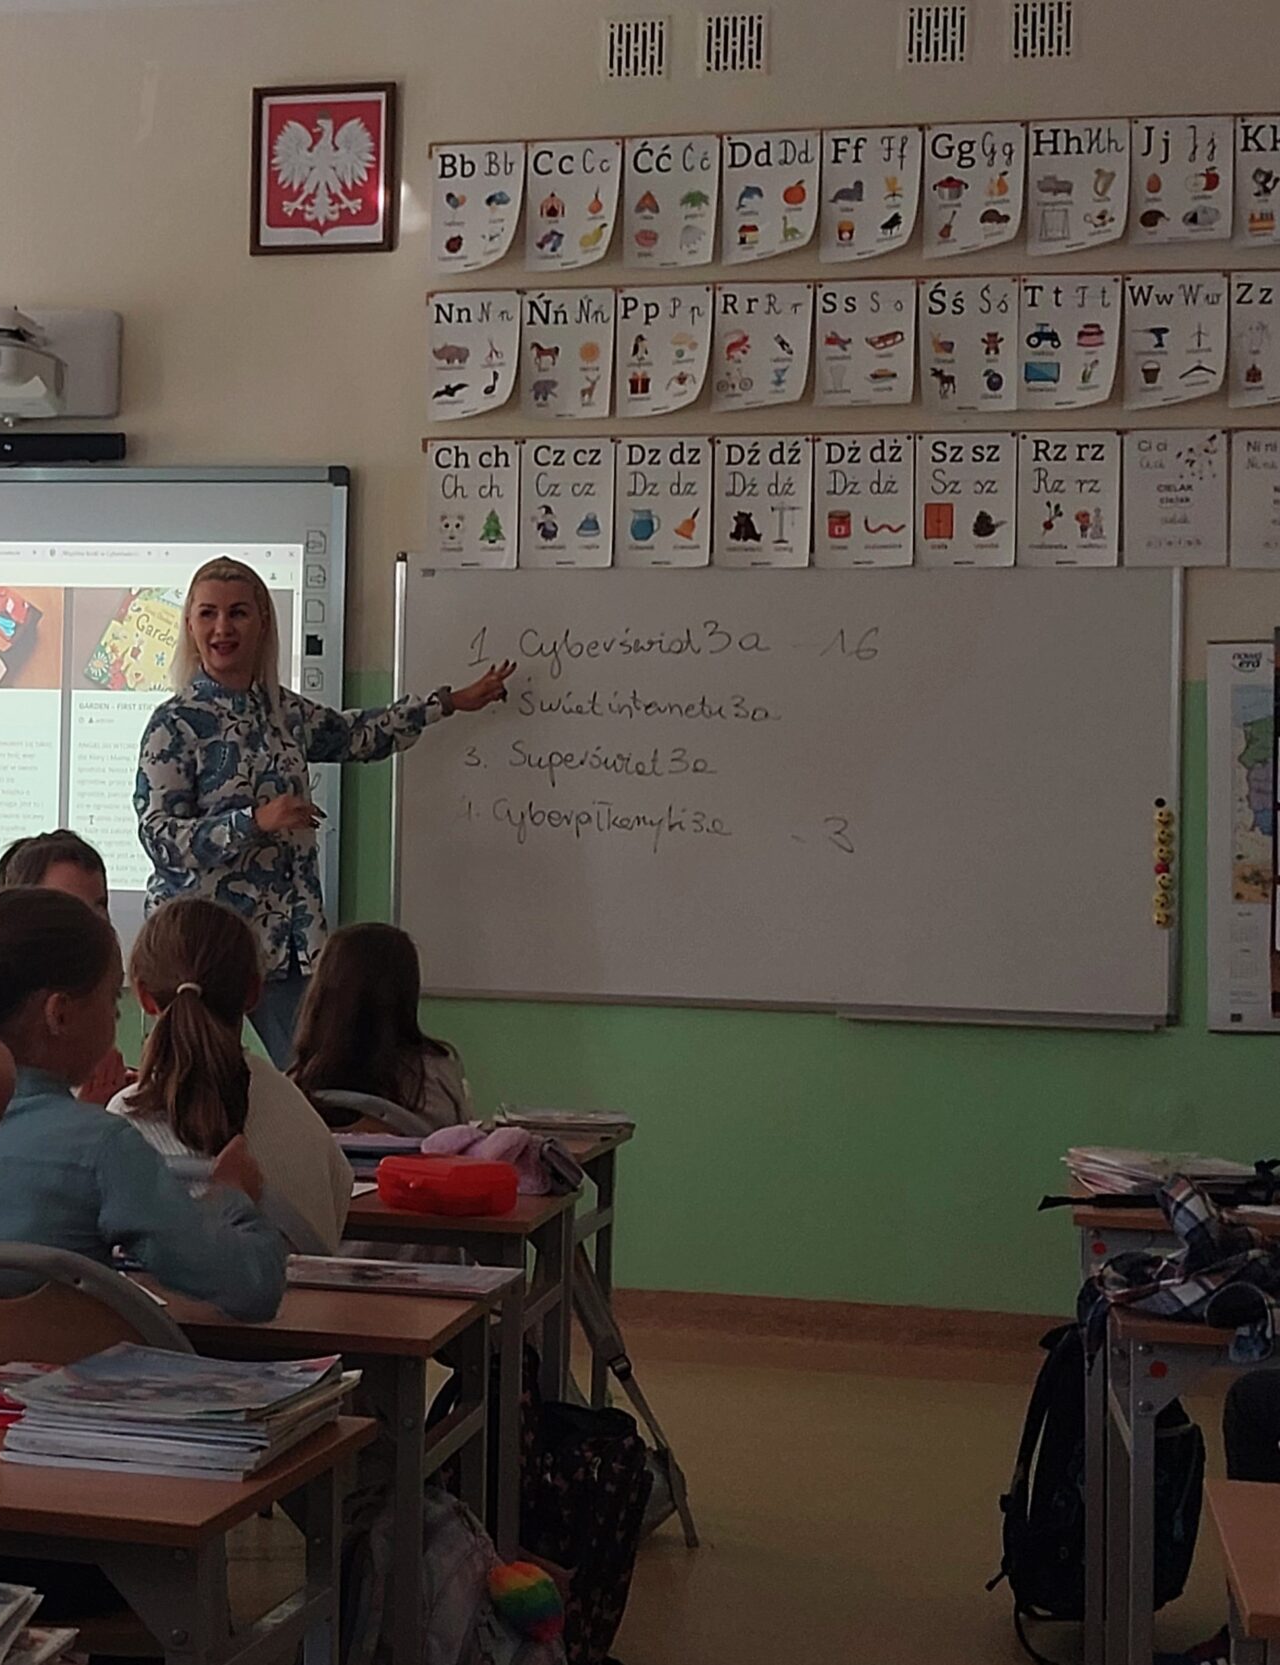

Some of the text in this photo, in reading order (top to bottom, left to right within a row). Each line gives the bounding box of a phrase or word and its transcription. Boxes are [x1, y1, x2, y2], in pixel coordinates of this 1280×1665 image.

[728, 141, 773, 168] Dd
[830, 134, 867, 164] Ff
[931, 133, 976, 167] Gg
[1032, 129, 1082, 156] Hh
[1141, 127, 1171, 165] Jj
[438, 153, 475, 179] Bb
[532, 150, 574, 175] Cc
[633, 142, 672, 174] Ćć
[721, 296, 759, 315] Rr
[821, 292, 857, 314] Ss
[928, 282, 964, 316] Śś
[1025, 285, 1063, 307] Tt
[1129, 285, 1173, 307] Ww
[1235, 282, 1272, 305] Zz
[434, 303, 472, 324] Nn
[526, 293, 568, 325] Ńń
[621, 297, 659, 325] Pp
[435, 445, 510, 468] Ch ch
[534, 446, 601, 466] Cz cz
[627, 442, 700, 465] Dz dz
[726, 441, 801, 465] Dź dź
[825, 439, 902, 464] Dż dż
[930, 441, 1000, 463] Sz sz
[1032, 440, 1104, 462] Rz rz
[442, 474, 467, 499] Ch
[535, 473, 561, 497] Cz
[627, 472, 659, 496] Dz
[726, 472, 760, 496] Dź
[825, 470, 861, 496] Dż
[931, 469, 962, 494] Sz
[1032, 468, 1065, 493] Rz
